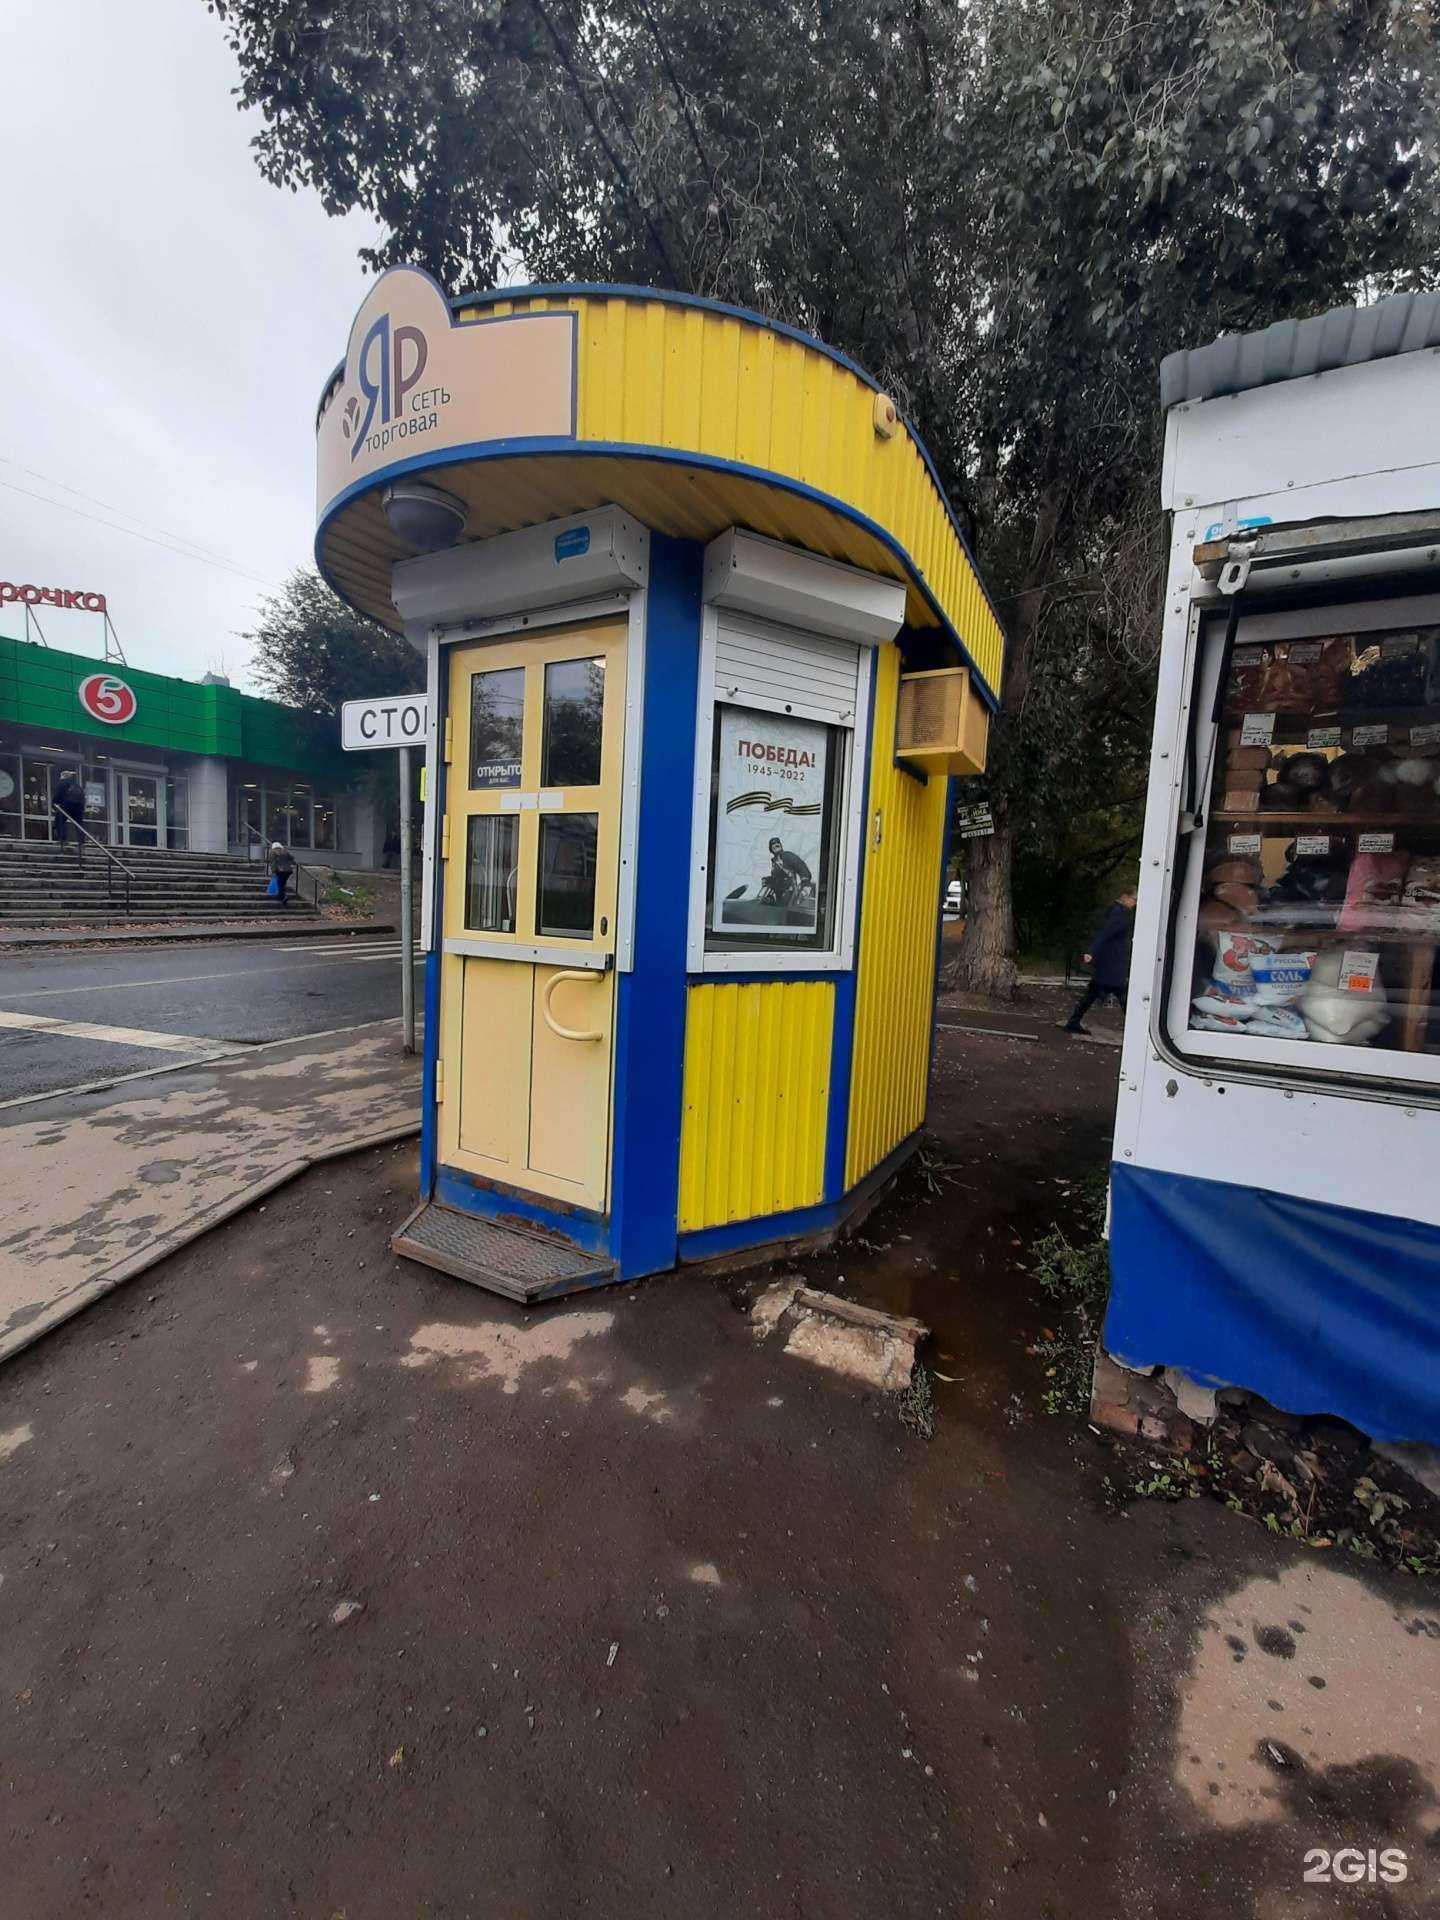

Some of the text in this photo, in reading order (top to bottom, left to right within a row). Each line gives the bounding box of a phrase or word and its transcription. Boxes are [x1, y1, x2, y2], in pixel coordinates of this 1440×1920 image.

[351, 313, 428, 464] ЯР
[411, 387, 451, 412] СЕТЬ
[365, 412, 438, 453] торговая
[97, 679, 125, 714] 5
[738, 739, 816, 769] ПОБЕДА!
[477, 764, 522, 778] ОТКРЫТО
[747, 763, 805, 781] 1945-2022
[1270, 971, 1304, 982] СОЛЬ
